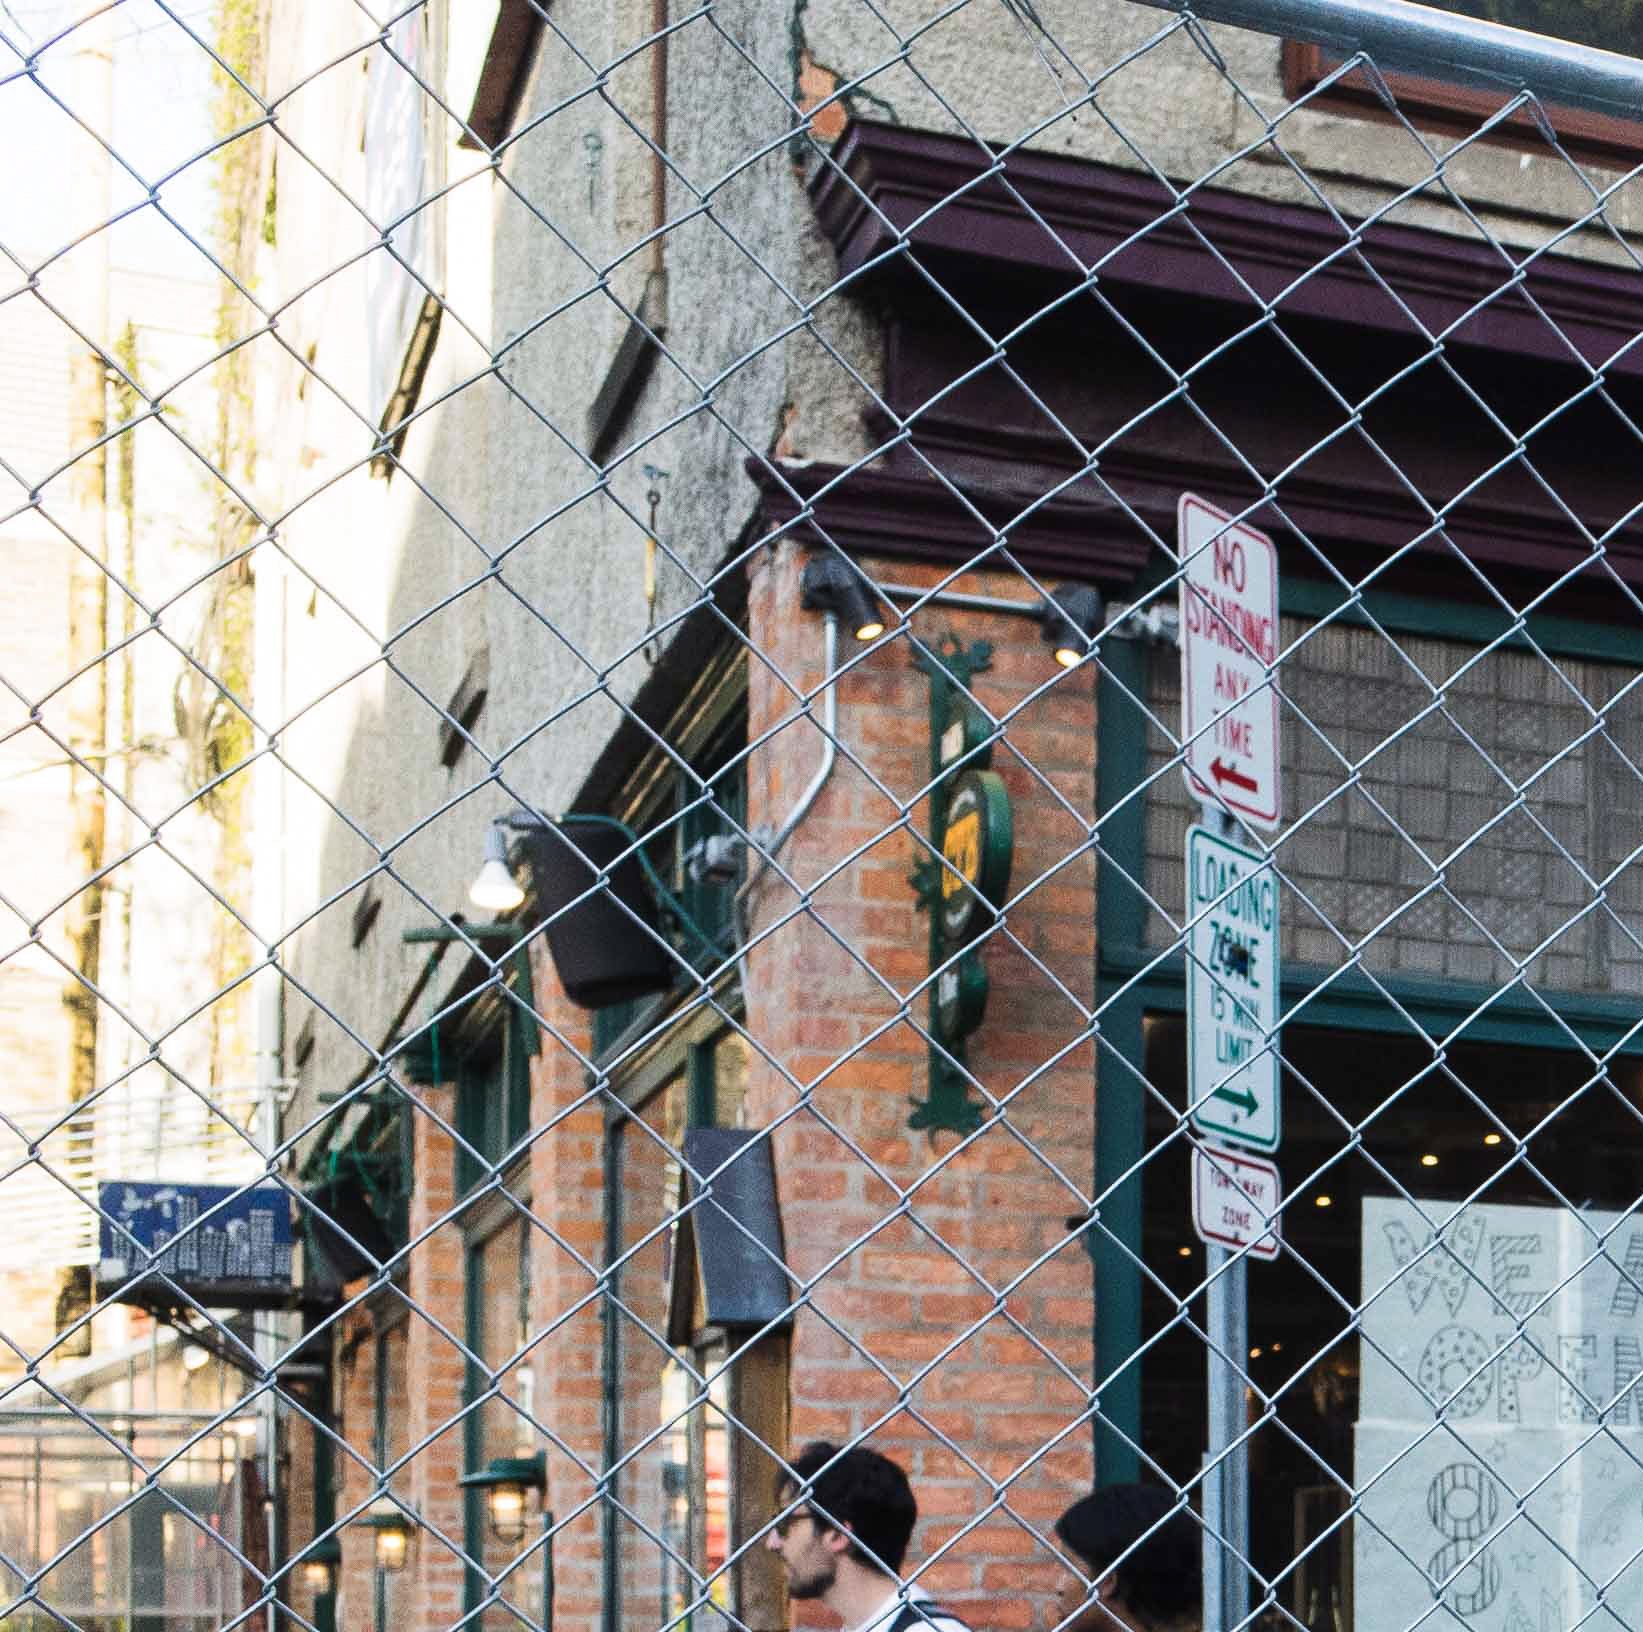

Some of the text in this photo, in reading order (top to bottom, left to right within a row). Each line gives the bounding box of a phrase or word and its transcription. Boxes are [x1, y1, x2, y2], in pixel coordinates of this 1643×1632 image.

[1213, 532, 1246, 593] NO
[1186, 586, 1274, 668] STANDING
[1196, 850, 1272, 931] LOADING
[1383, 1214, 1552, 1317] WE
